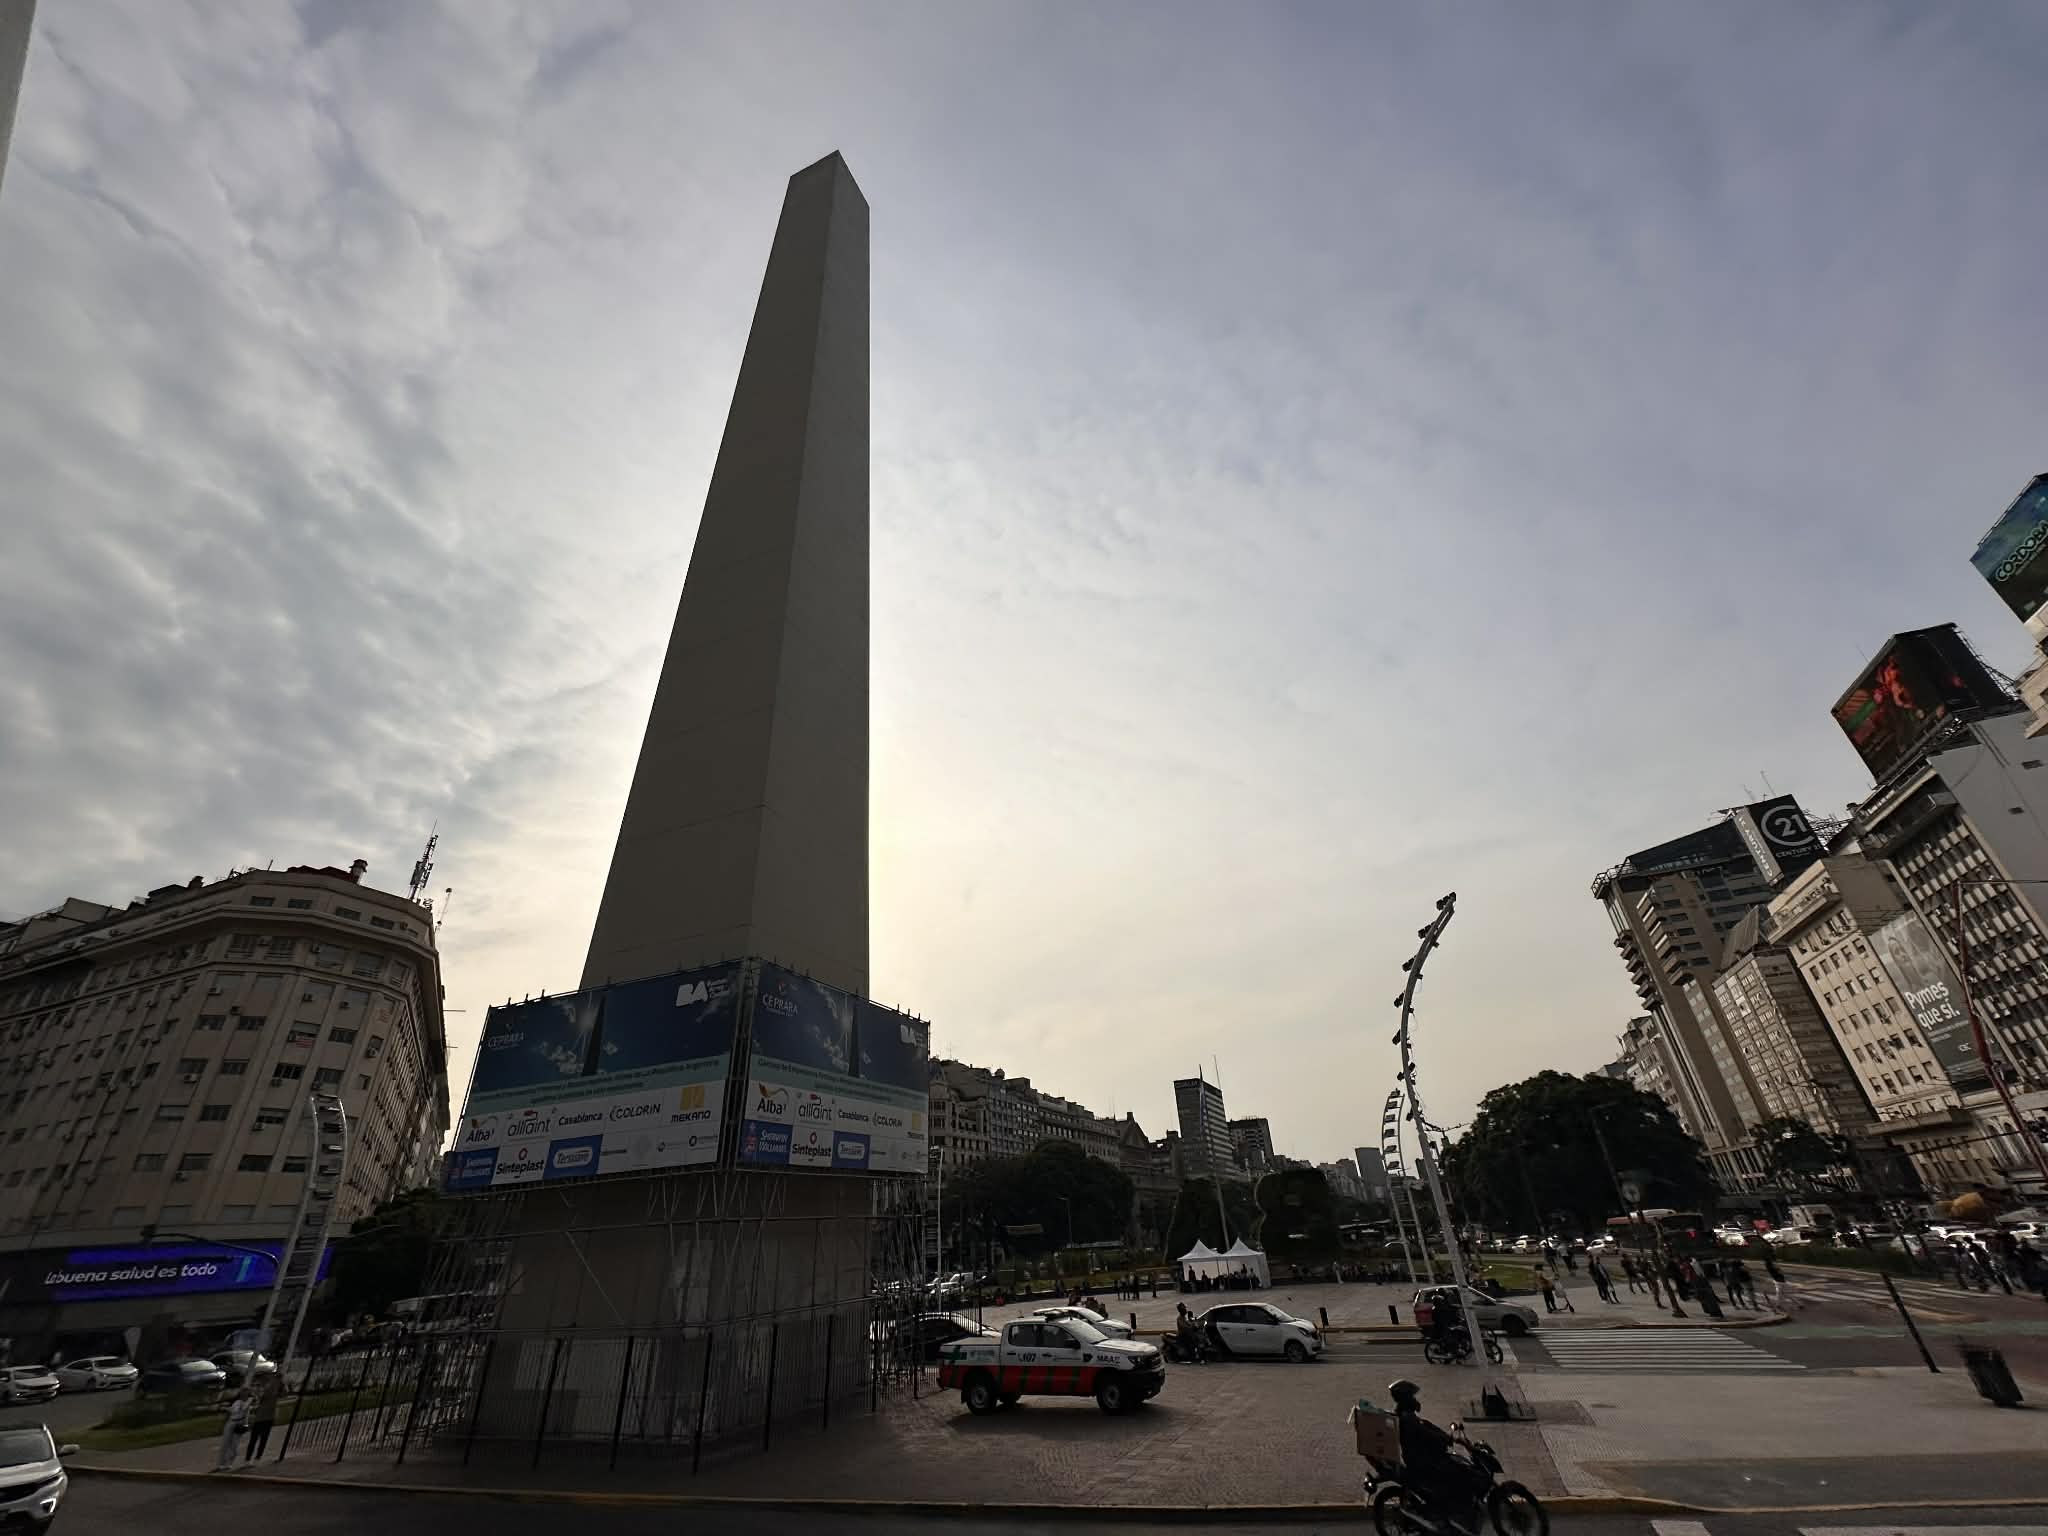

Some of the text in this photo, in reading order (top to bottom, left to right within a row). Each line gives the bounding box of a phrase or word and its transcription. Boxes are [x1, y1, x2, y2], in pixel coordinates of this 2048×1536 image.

[1774, 814, 1807, 837] 21
[1904, 981, 1949, 1011] Pymes
[1917, 1006, 1941, 1031] que
[616, 1103, 661, 1119] COLORIN
[757, 1098, 783, 1114] Alba
[558, 1111, 603, 1126] Casablanca
[466, 1127, 491, 1142] Alba
[792, 1142, 831, 1158] Sinteplast
[497, 1159, 544, 1176] Sinteplast
[55, 1270, 107, 1284] buena
[110, 1265, 158, 1280] salud
[158, 1267, 178, 1278] es
[180, 1262, 217, 1278] todo
